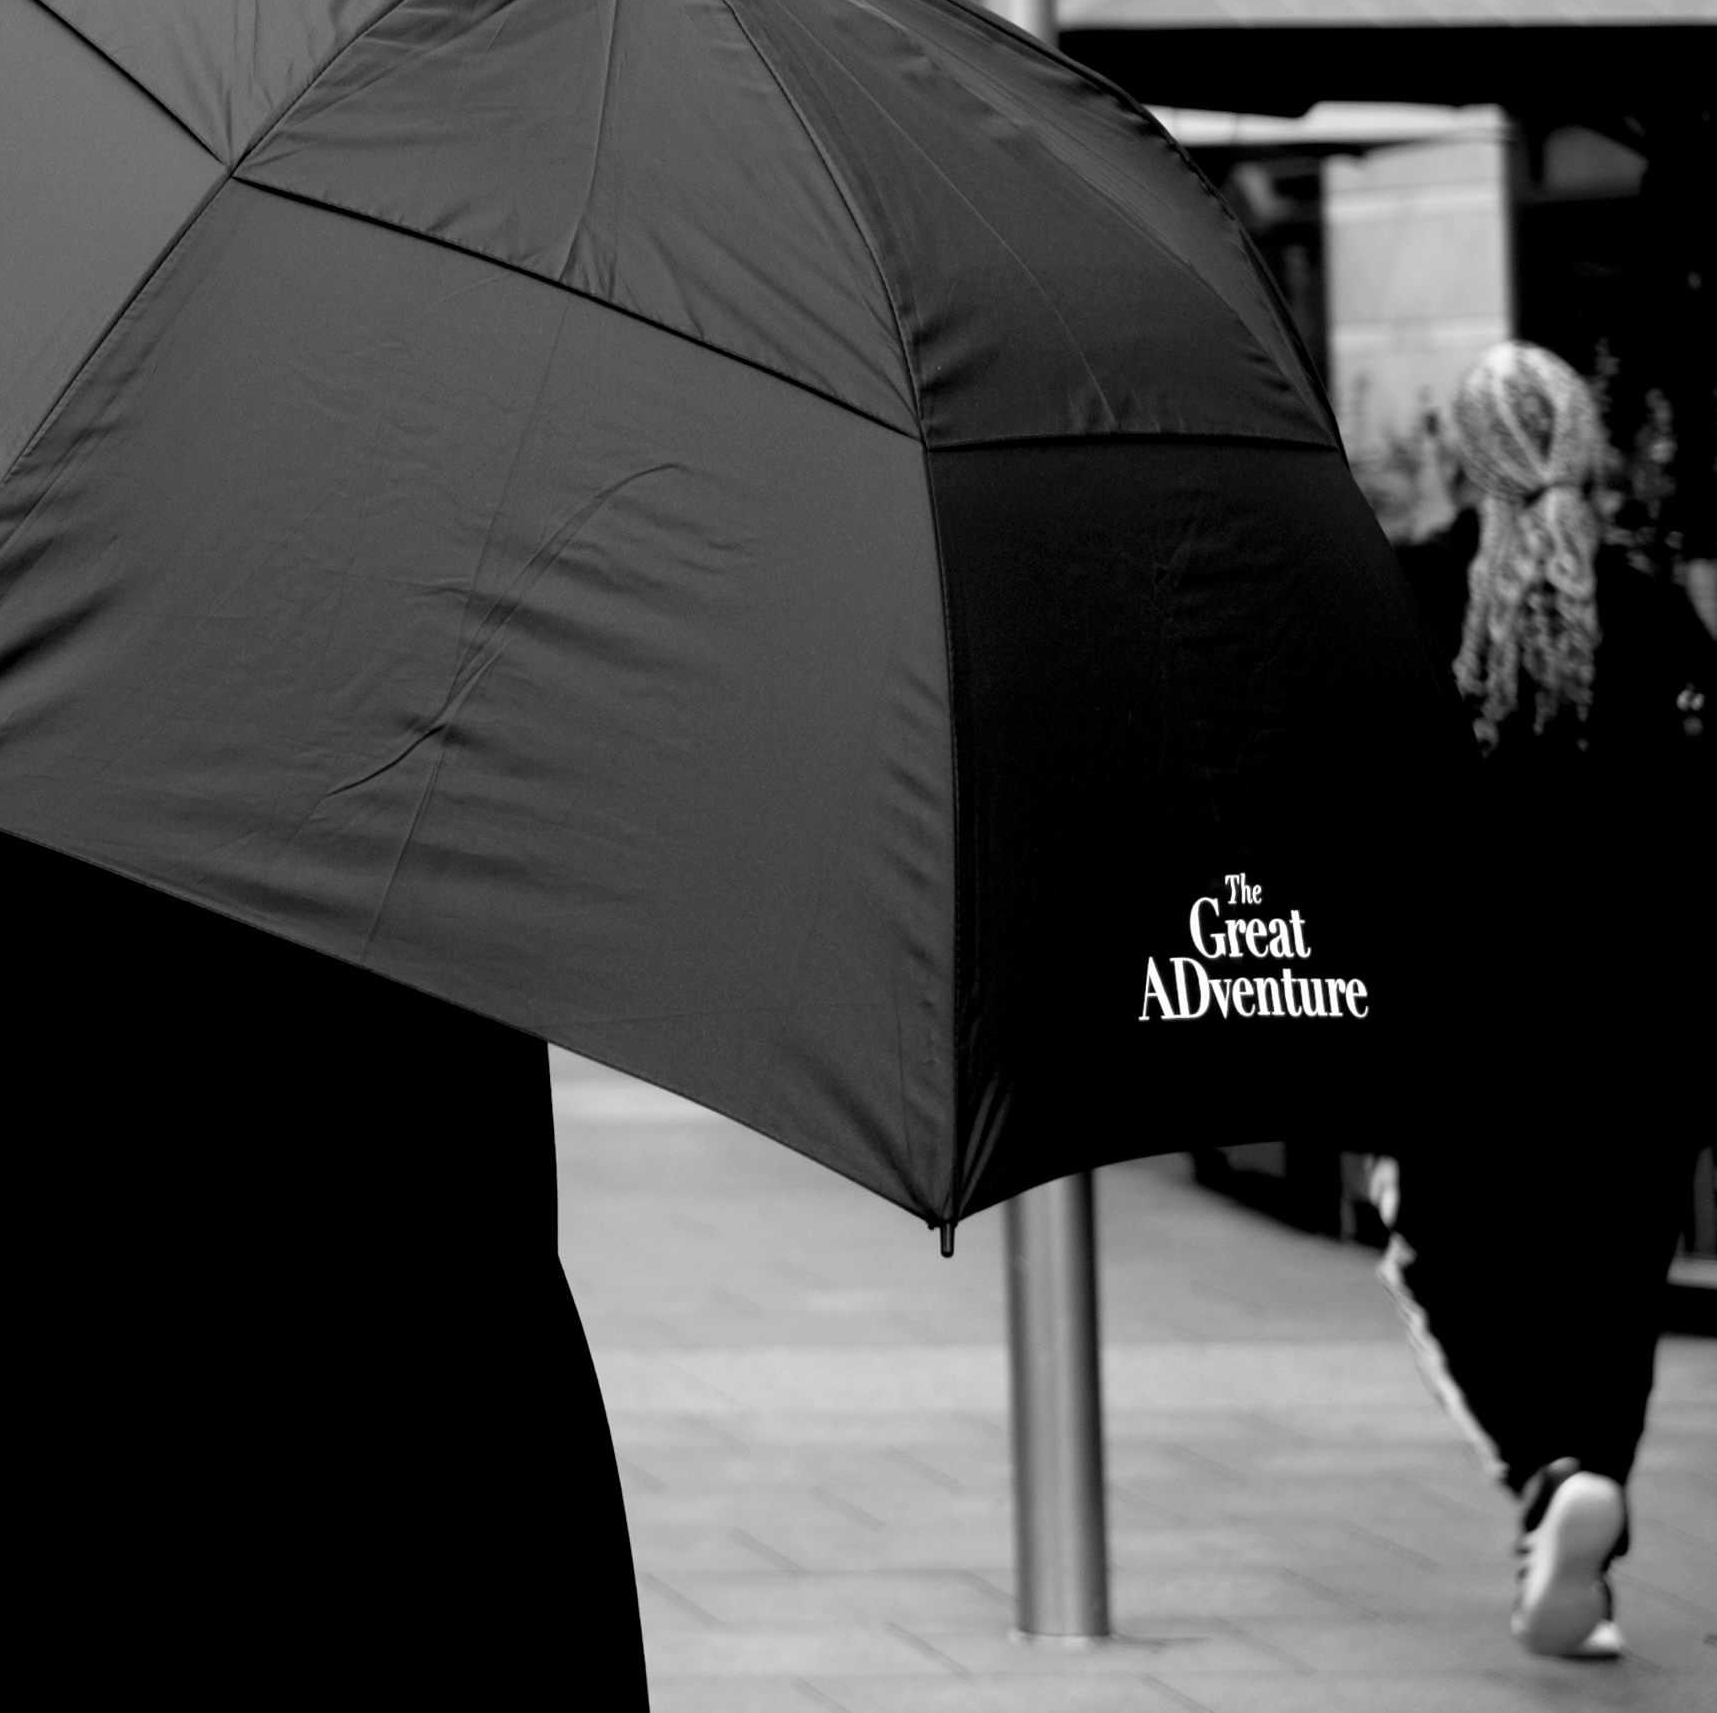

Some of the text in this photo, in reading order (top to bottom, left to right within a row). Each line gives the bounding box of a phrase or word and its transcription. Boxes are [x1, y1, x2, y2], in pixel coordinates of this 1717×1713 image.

[1224, 872, 1263, 905] The
[1189, 896, 1311, 959] Great
[1138, 956, 1369, 1021] ADventure
